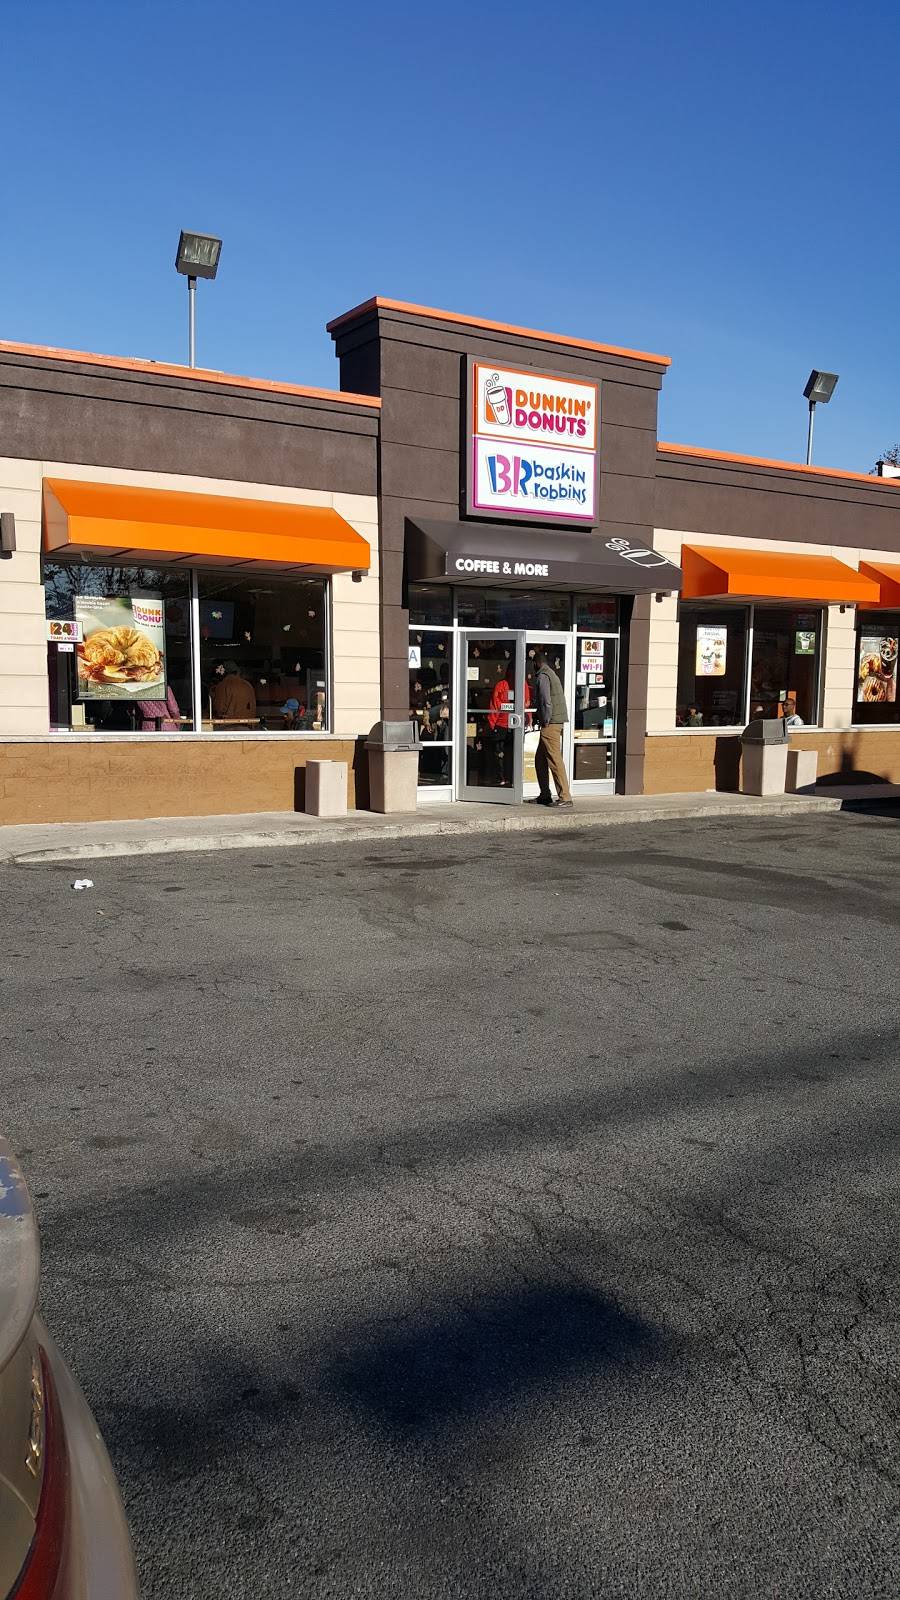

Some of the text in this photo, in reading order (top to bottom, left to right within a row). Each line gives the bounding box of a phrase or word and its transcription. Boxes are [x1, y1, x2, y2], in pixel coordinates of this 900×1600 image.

[515, 389, 591, 417] DUNKIN'
[515, 409, 586, 436] DONUTS
[487, 454, 532, 496] BR
[455, 558, 549, 576] COFFEE & MORE
[409, 649, 418, 662] A
[582, 663, 603, 671] WI-FI
